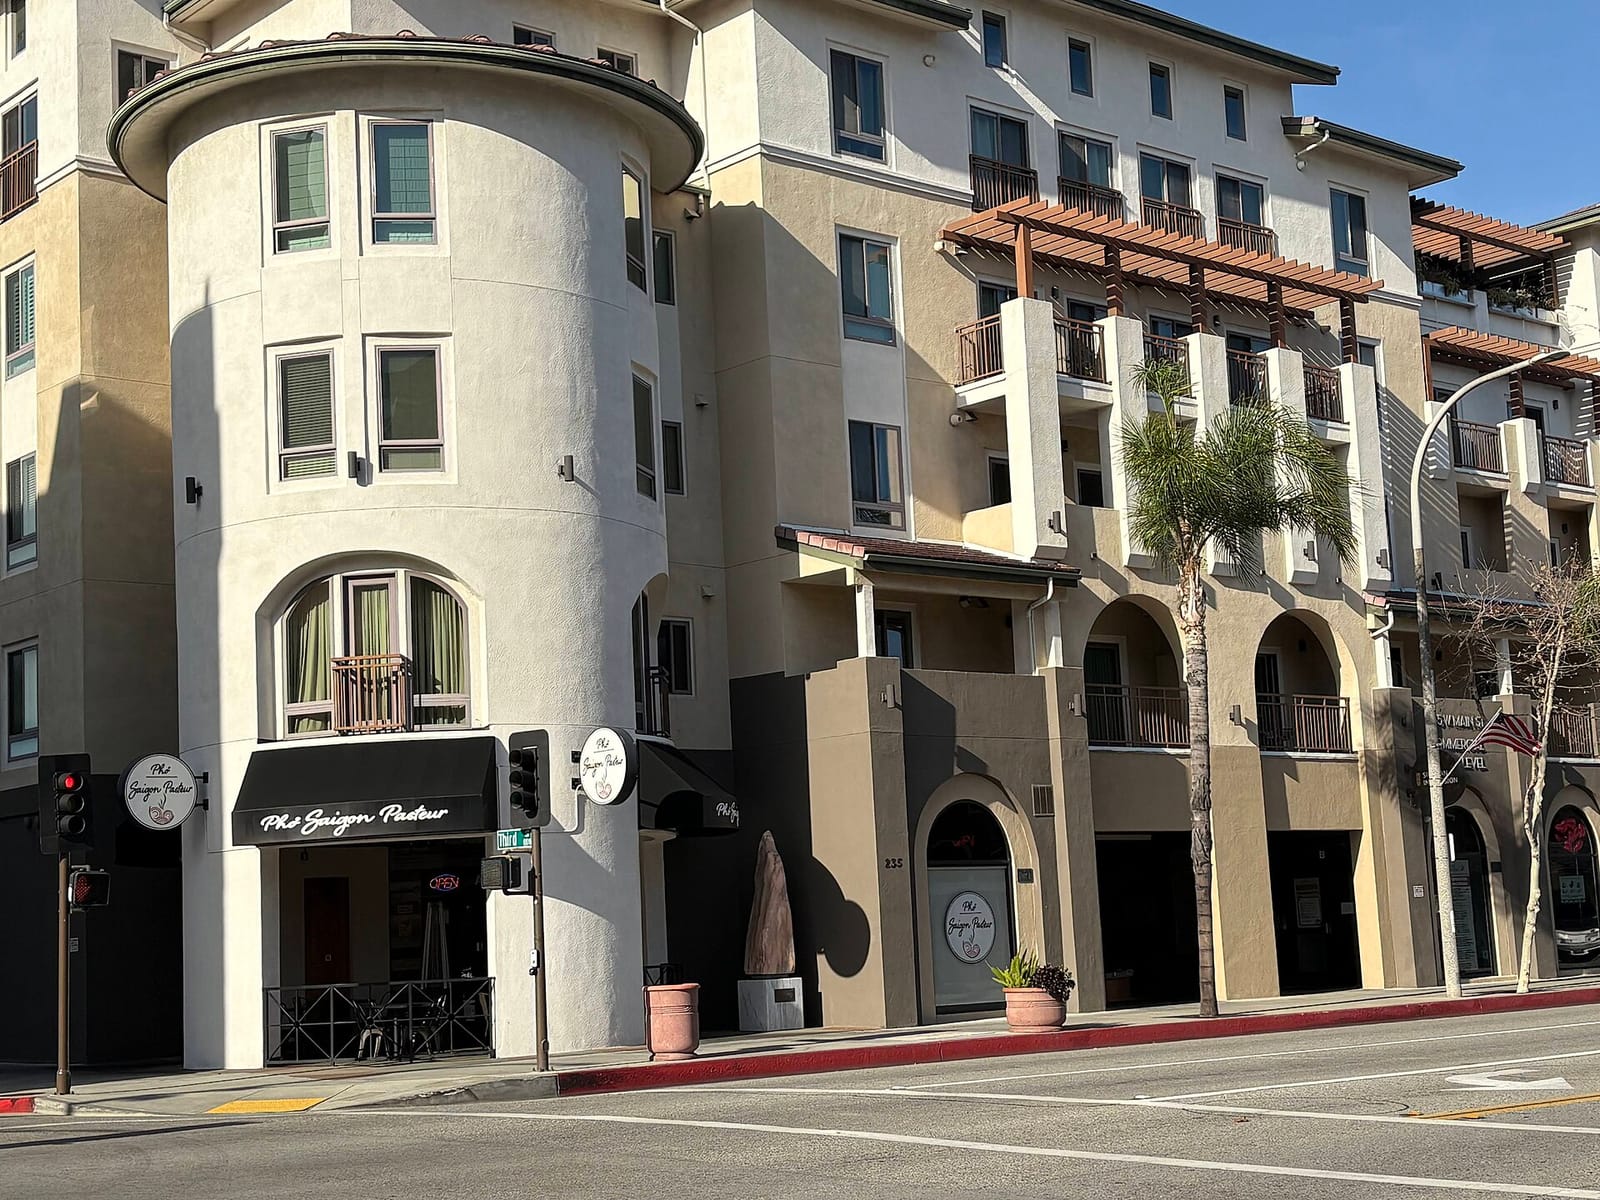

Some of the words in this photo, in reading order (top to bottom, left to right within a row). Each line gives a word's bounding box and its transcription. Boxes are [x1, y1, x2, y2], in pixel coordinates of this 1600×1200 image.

[127, 780, 162, 802] Saigon
[162, 780, 193, 794] Pasteur
[300, 808, 376, 837] Saigon
[378, 804, 449, 823] Pasteur
[498, 831, 517, 848] Third
[885, 858, 903, 869] 235
[429, 876, 460, 889] OPEN
